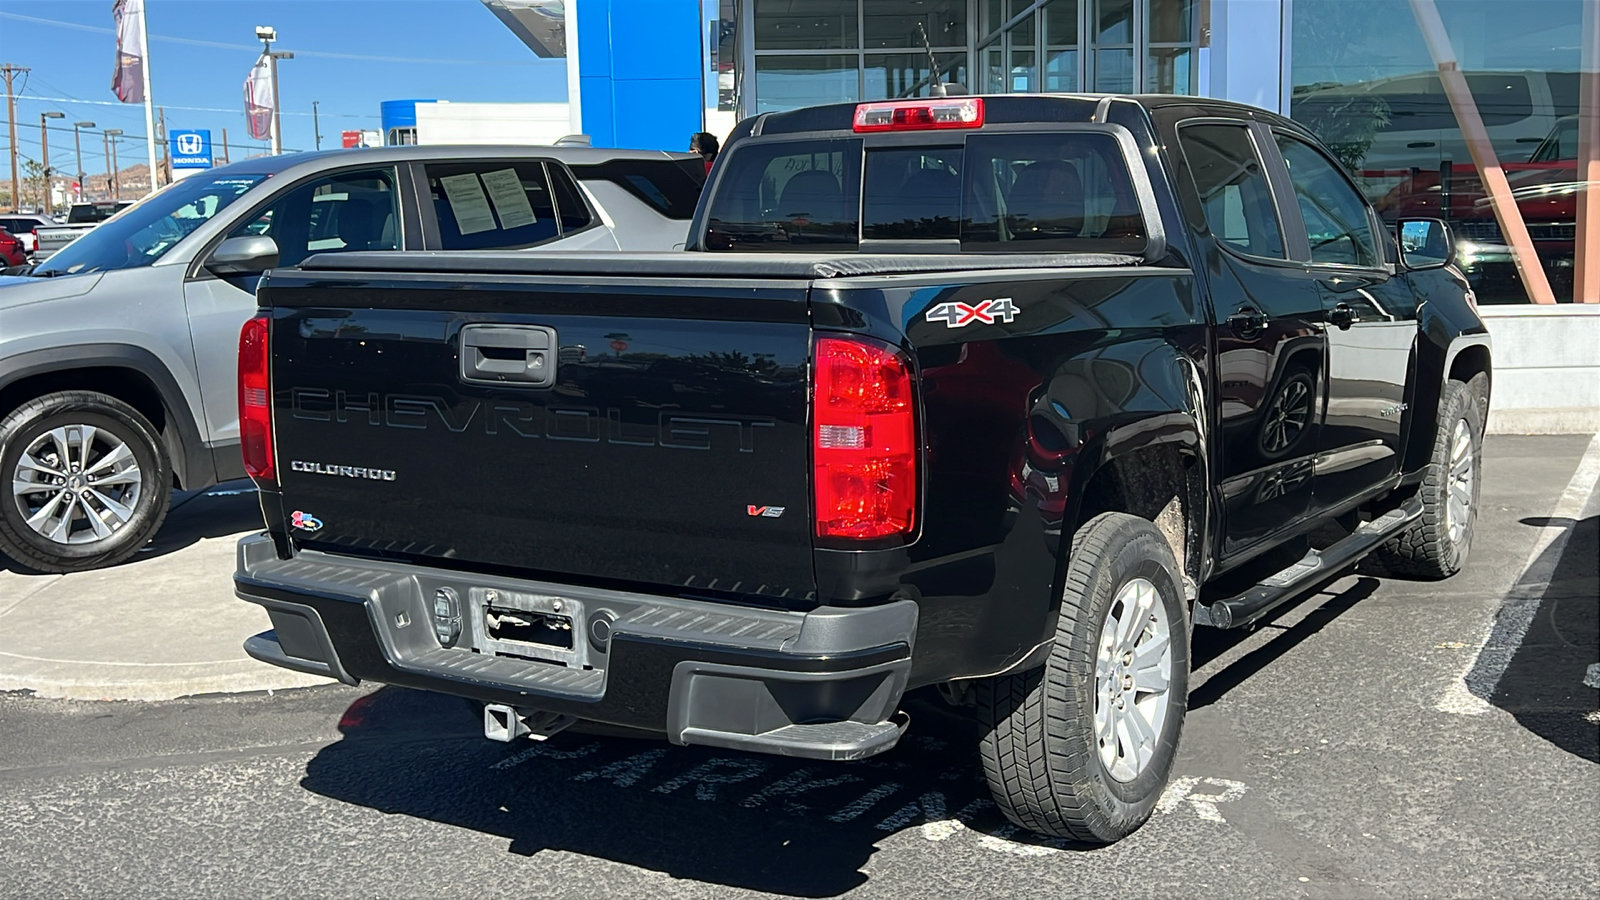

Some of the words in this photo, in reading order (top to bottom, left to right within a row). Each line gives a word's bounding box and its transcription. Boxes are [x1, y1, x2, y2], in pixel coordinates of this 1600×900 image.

[292, 387, 775, 453] CHEVROLET
[291, 460, 397, 481] COLORADO
[747, 504, 786, 519] V6
